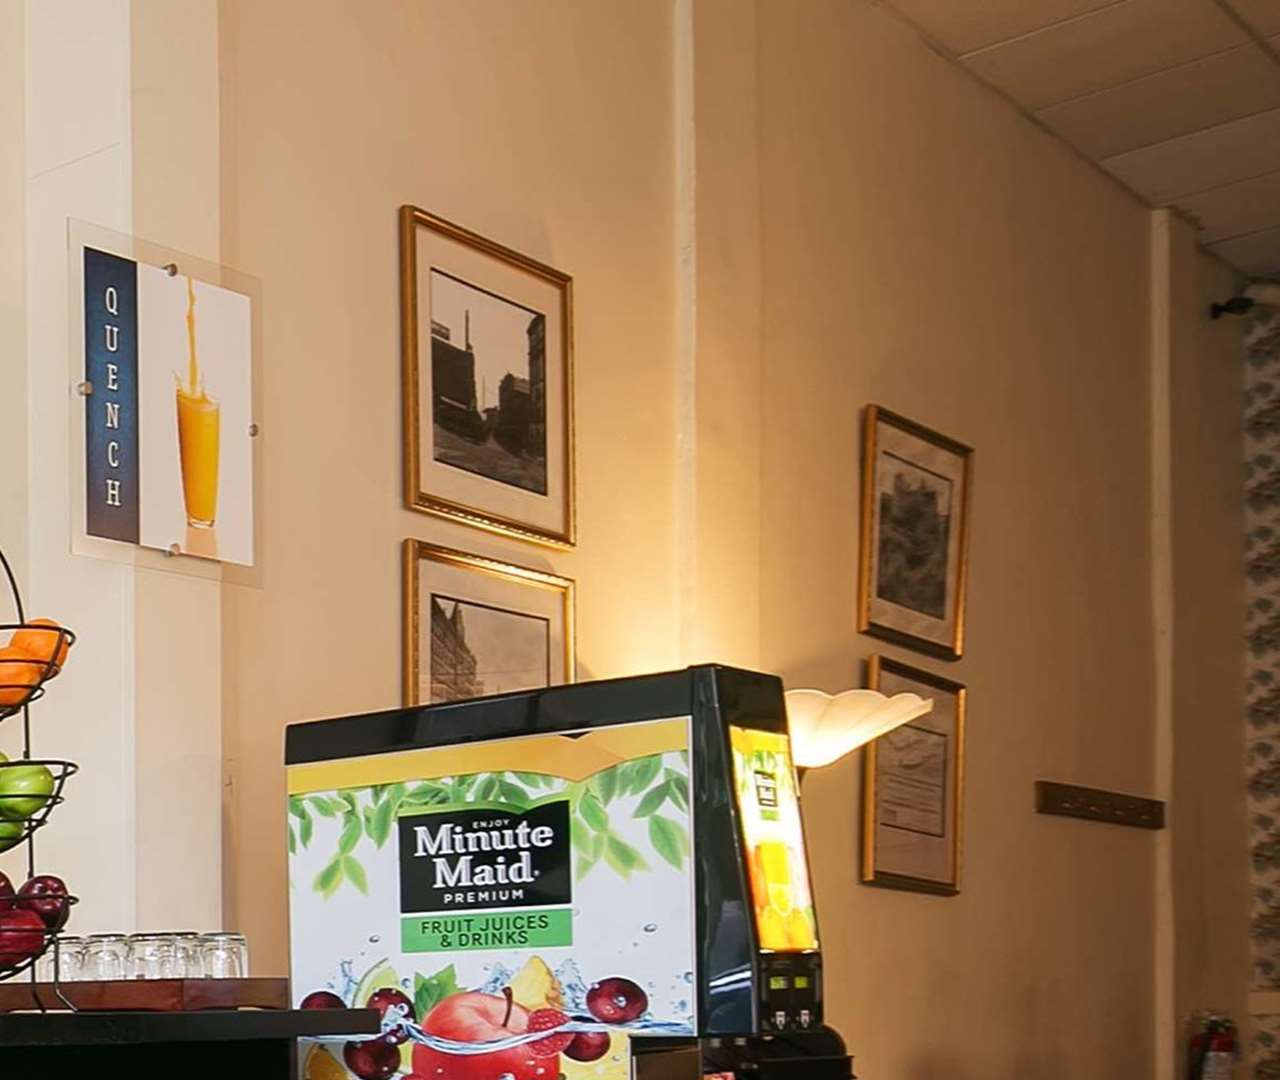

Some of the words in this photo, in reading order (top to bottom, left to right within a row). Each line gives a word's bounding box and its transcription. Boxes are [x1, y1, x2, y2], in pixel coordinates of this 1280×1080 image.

[105, 287, 121, 507] QUENCH
[472, 819, 510, 829] ENJOY
[413, 820, 554, 857] Minute
[432, 851, 535, 888] Maid
[444, 889, 524, 904] PREMIUM
[421, 918, 474, 934] FRUIT
[479, 914, 549, 932] JUICES
[440, 934, 452, 948] &
[458, 930, 529, 947] DRINKS
